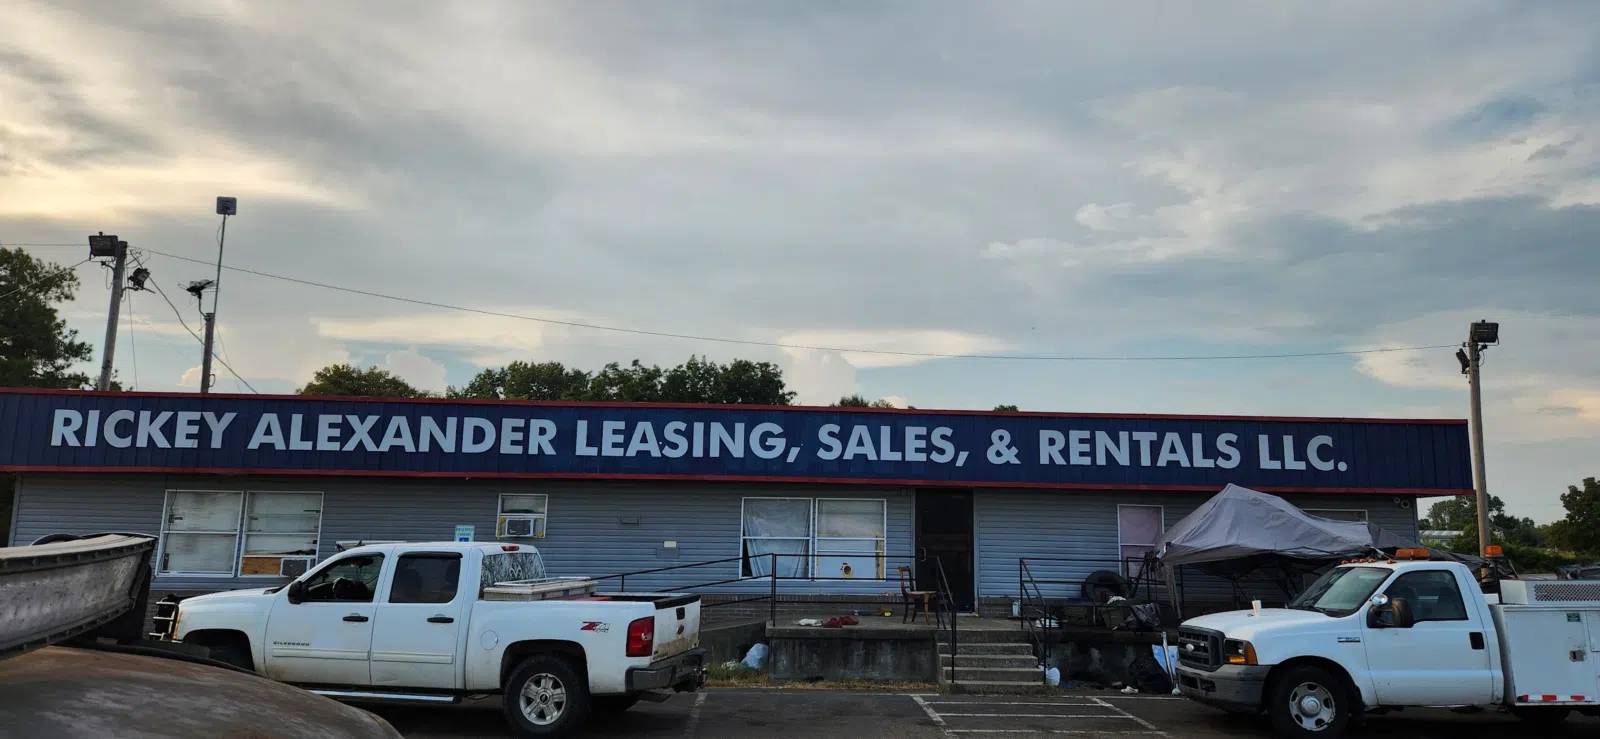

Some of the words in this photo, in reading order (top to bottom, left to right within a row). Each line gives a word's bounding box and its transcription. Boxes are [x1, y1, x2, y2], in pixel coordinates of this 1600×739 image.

[50, 409, 238, 449] RICKEY
[247, 413, 557, 456] ALEXANDER
[575, 419, 801, 463] LEASING,
[816, 423, 970, 467] SALES,
[986, 429, 1021, 465] &
[1039, 429, 1241, 469] RENTALS
[1258, 434, 1348, 472] LLC.
